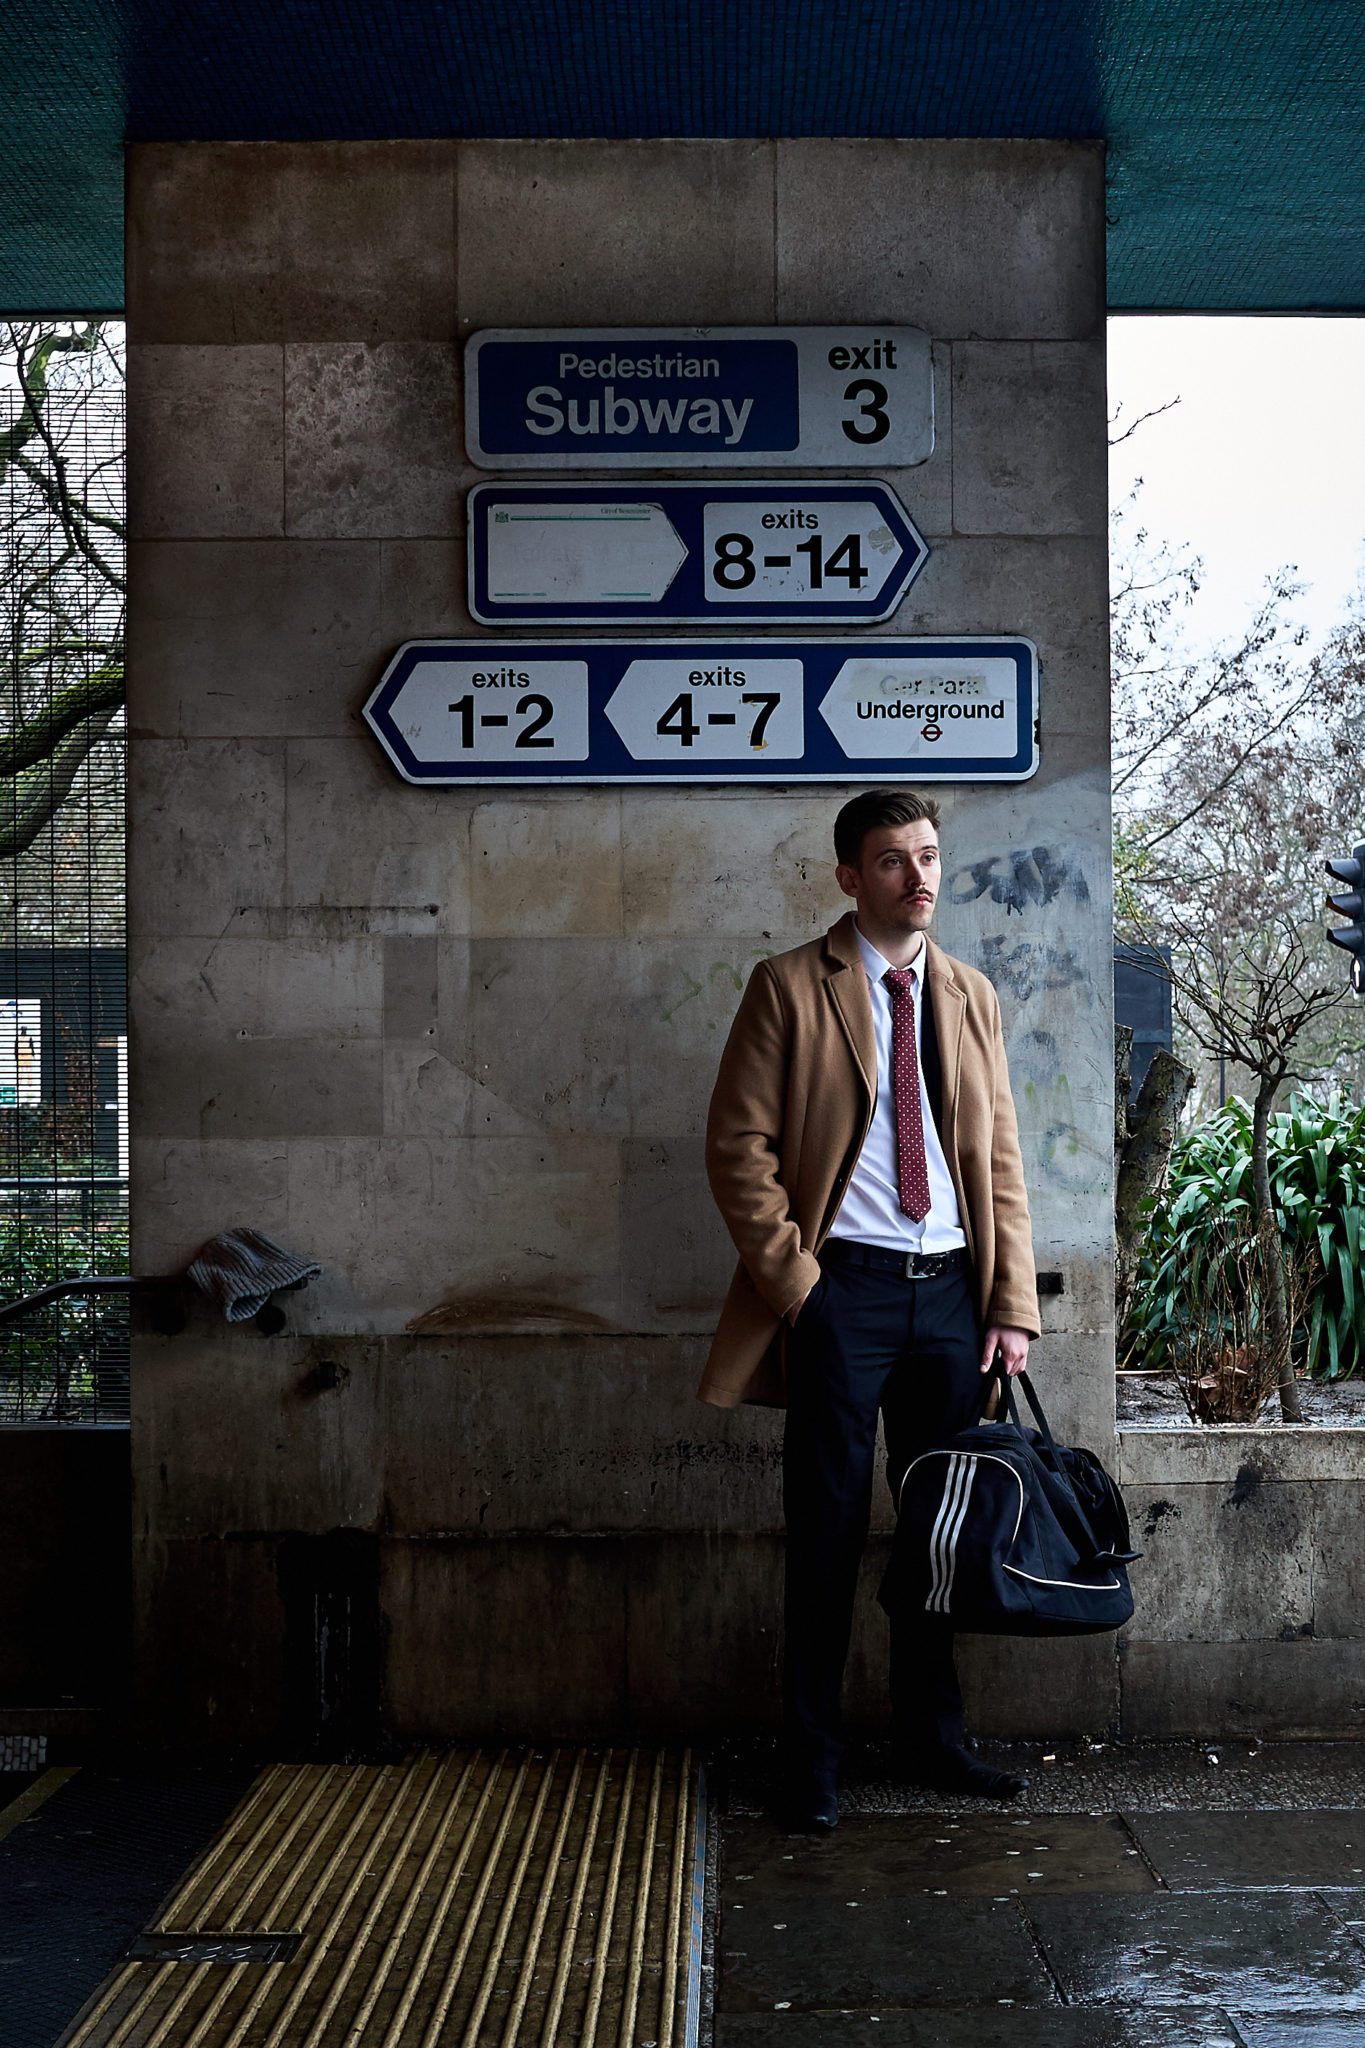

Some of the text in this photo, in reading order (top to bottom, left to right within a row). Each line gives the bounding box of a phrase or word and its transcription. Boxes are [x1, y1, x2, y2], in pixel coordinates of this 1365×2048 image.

[560, 353, 720, 378] Pedestrian
[828, 339, 897, 370] exit
[525, 386, 754, 444] Subway
[842, 379, 891, 444] 3
[761, 509, 819, 530] exits
[713, 533, 868, 589] 8-14
[471, 668, 530, 689] exits
[688, 666, 746, 687] exits
[448, 694, 555, 749] 1-2
[656, 693, 781, 747] 4-7
[856, 700, 1004, 723] Underground
